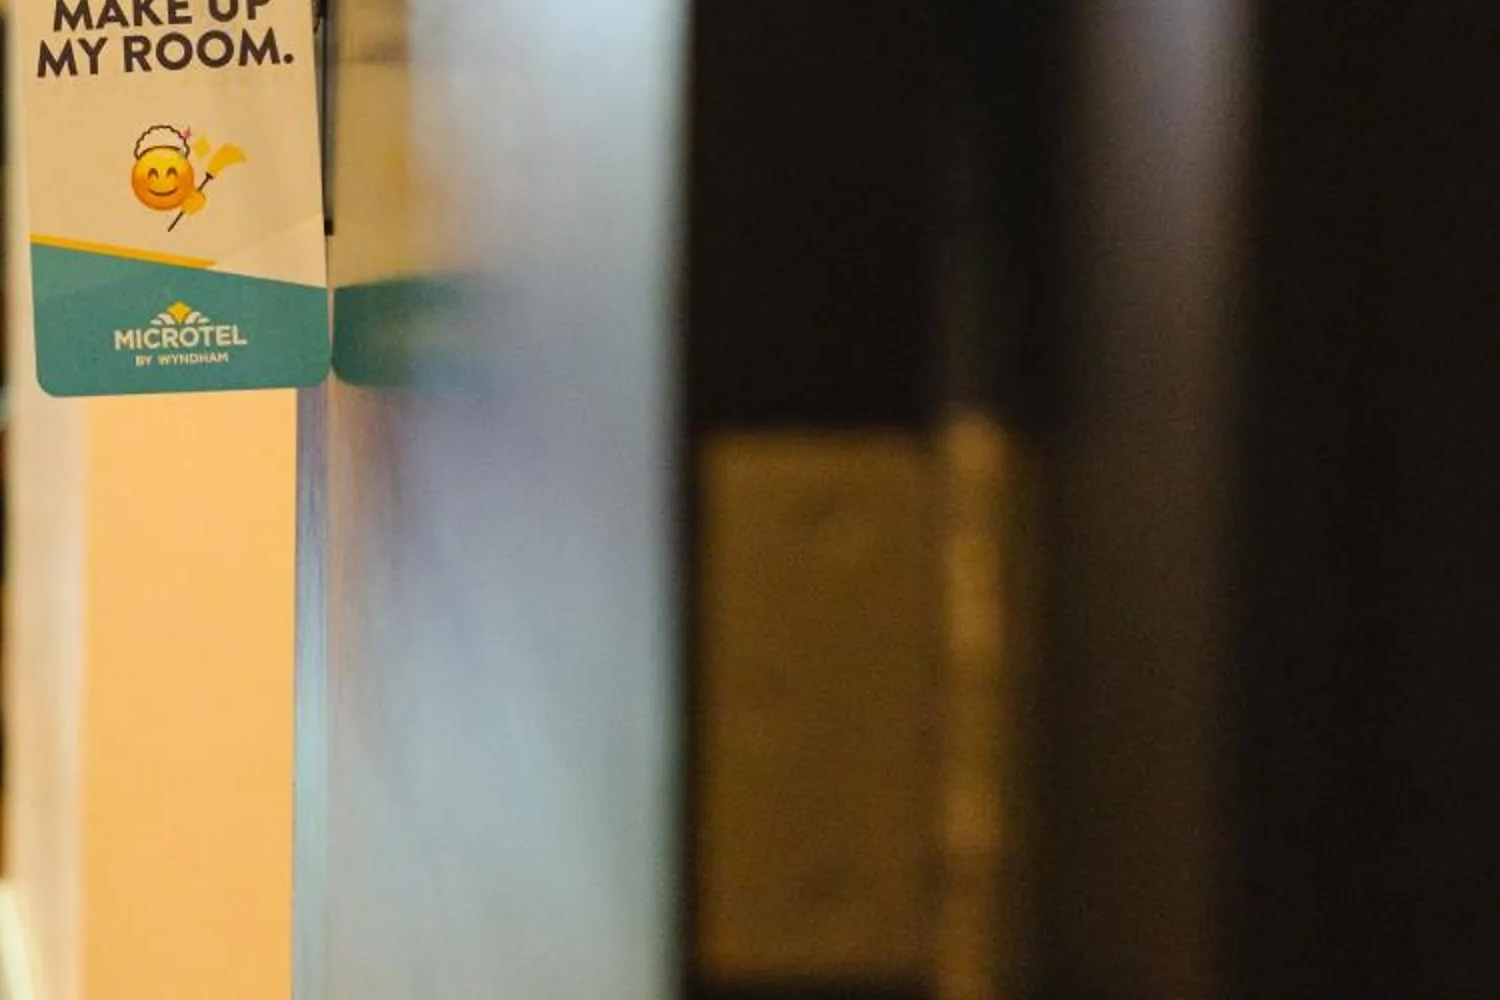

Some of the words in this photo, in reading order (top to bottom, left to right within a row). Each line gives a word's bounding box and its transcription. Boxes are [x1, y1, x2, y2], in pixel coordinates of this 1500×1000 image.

[37, 37, 108, 78] MY
[123, 27, 294, 73] ROOM.
[114, 324, 248, 350] MICROTEL
[135, 354, 152, 367] BY
[158, 352, 229, 366] WYNDHAM
